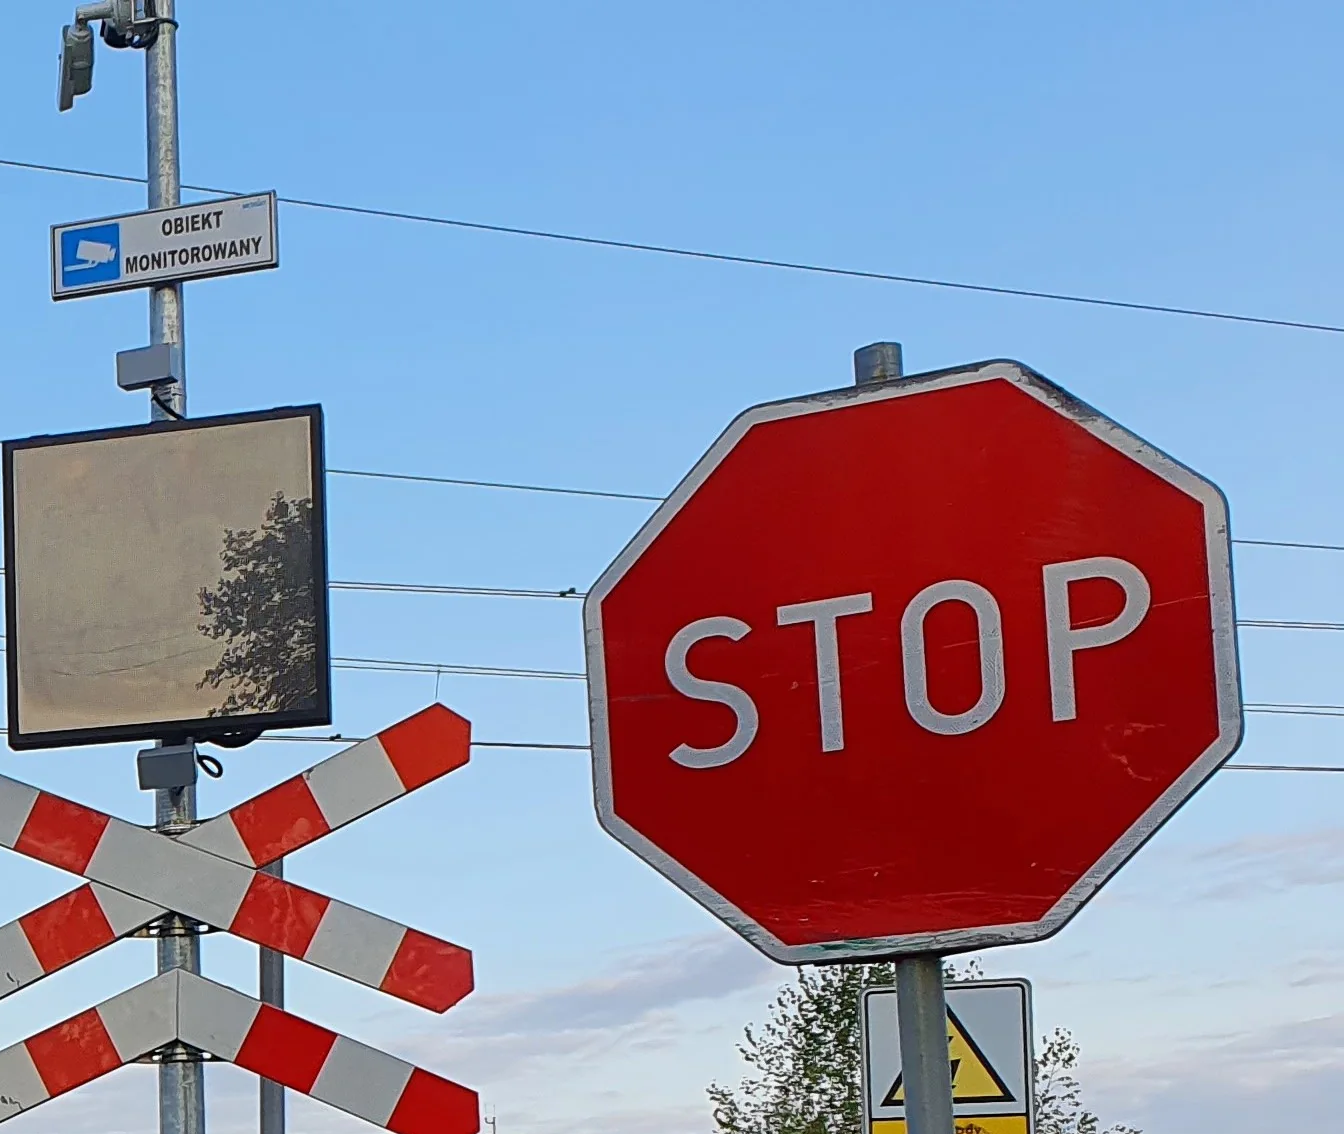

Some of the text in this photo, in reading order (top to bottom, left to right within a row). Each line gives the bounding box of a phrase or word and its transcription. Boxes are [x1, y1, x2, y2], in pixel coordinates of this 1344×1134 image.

[162, 210, 223, 237] OBIEKT
[125, 236, 262, 274] MONITOROWANY
[664, 556, 1151, 769] STOP
